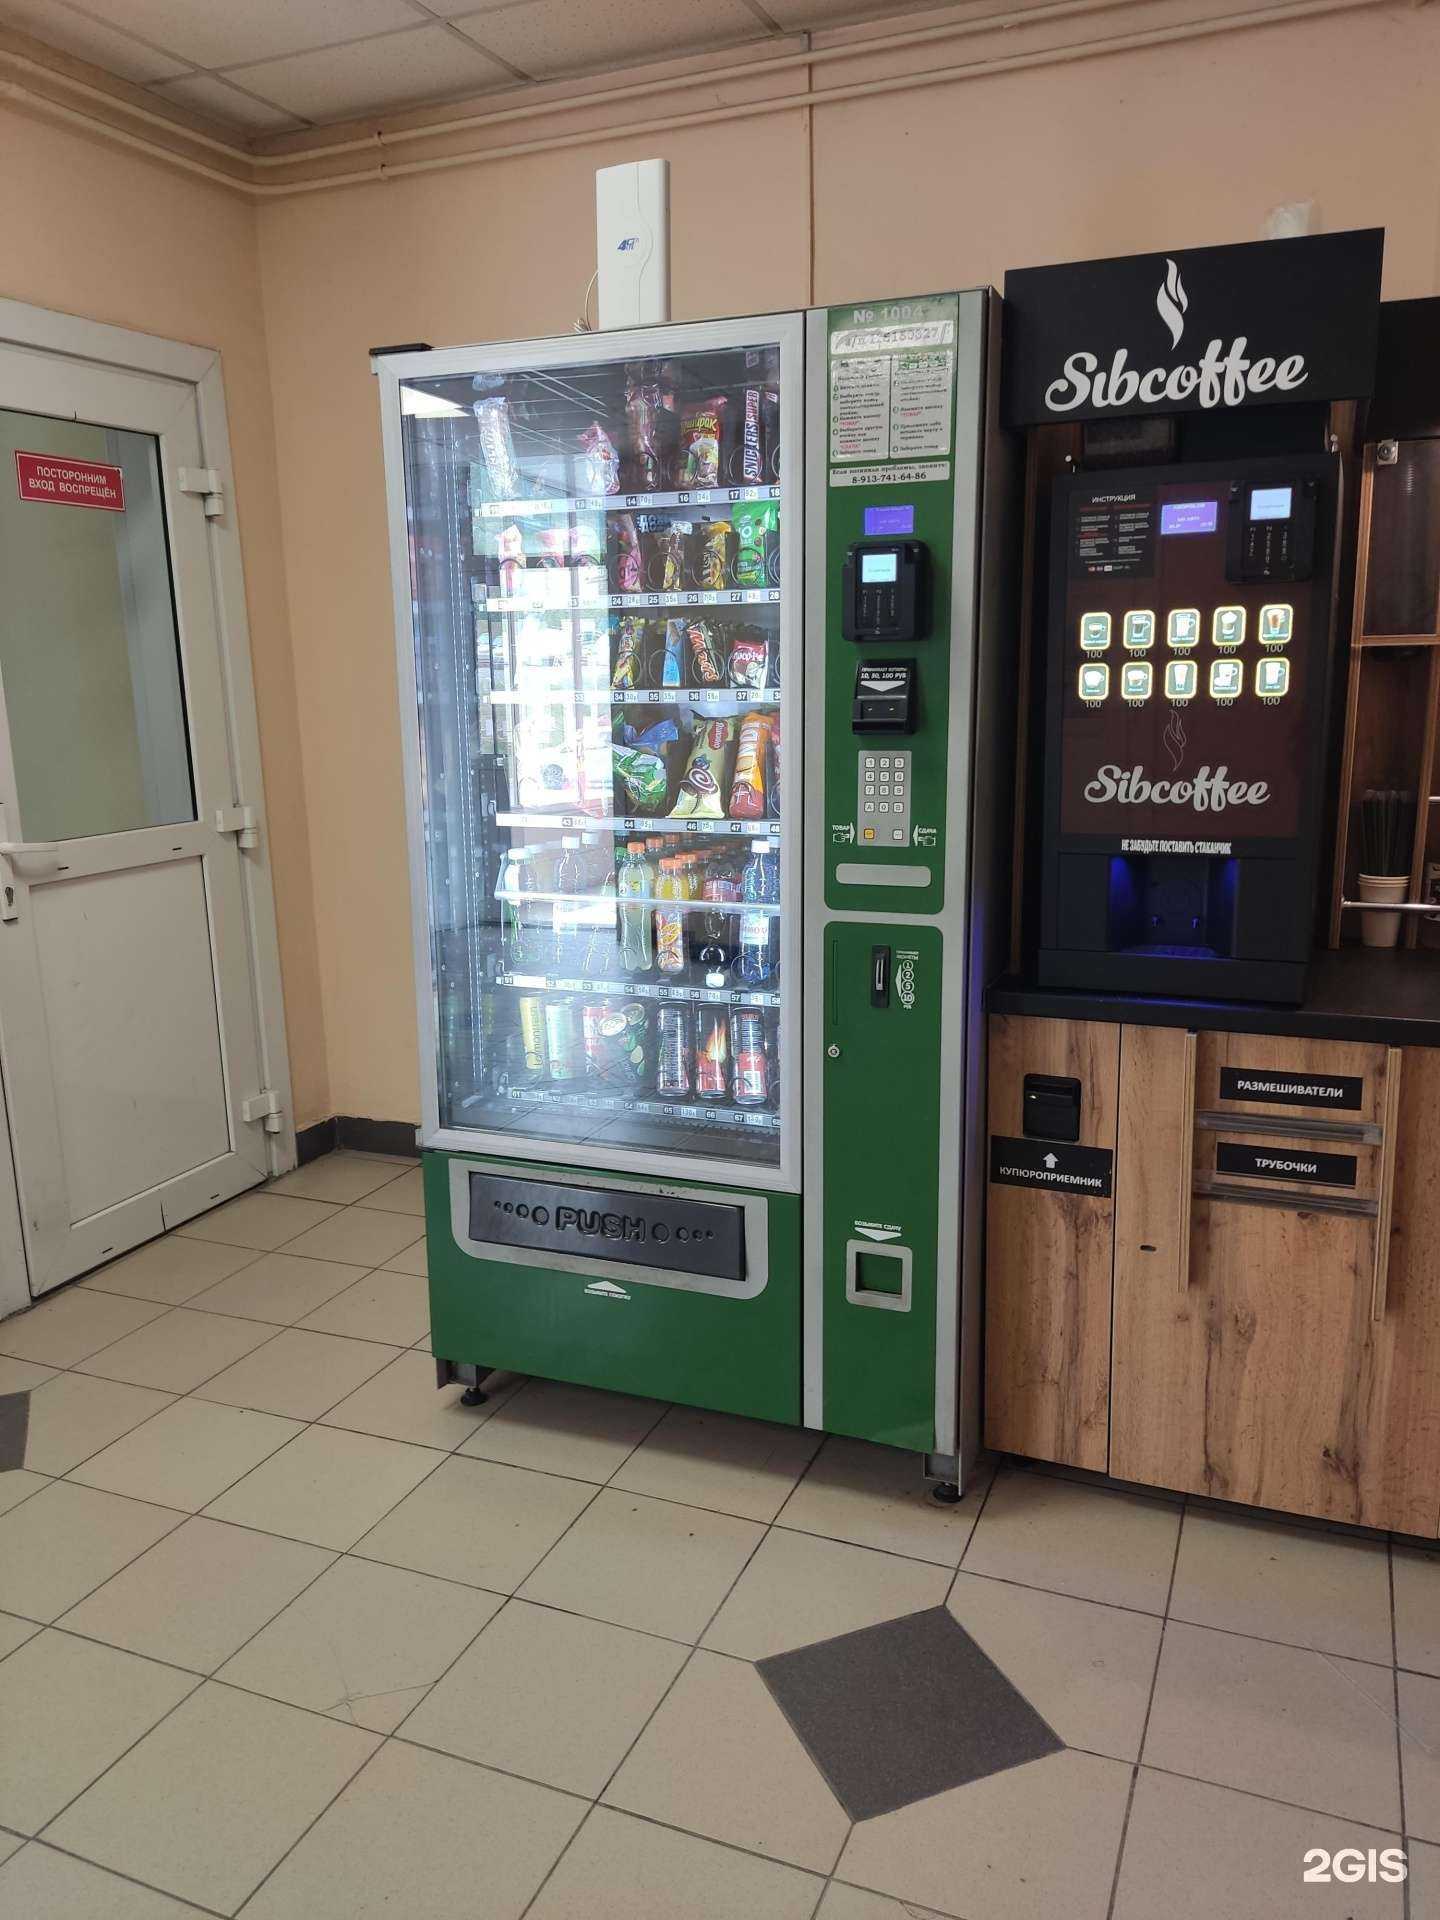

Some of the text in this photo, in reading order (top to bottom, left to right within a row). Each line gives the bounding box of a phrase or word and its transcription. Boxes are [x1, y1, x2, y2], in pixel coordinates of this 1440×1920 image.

[1044, 336, 1308, 412] Sibcoffee
[746, 390, 760, 422] SUPER
[36, 466, 106, 484] ПОСТОРОННИМ
[852, 472, 926, 484] 8-913-741-64-86
[29, 478, 55, 492] ВХОД
[771, 488, 780, 496] 18
[680, 494, 688, 502] 16
[1092, 494, 1136, 503] ИНСТРУКЦИЯ
[1265, 644, 1284, 652] 100
[1128, 699, 1144, 707] 100
[1262, 697, 1280, 705] 100
[1084, 764, 1271, 812] Sibcoffee
[1121, 839, 1129, 850] НЕ
[1160, 840, 1194, 853] ПОСТАВИТЬ
[1237, 1080, 1343, 1098] РАЗМЕШИВАТЕЛИ
[1255, 1158, 1317, 1173] ТРУБОЧКИ
[1000, 1166, 1102, 1187] КУПЮРОПРИЕМНИК
[556, 1206, 646, 1244] PUSH
